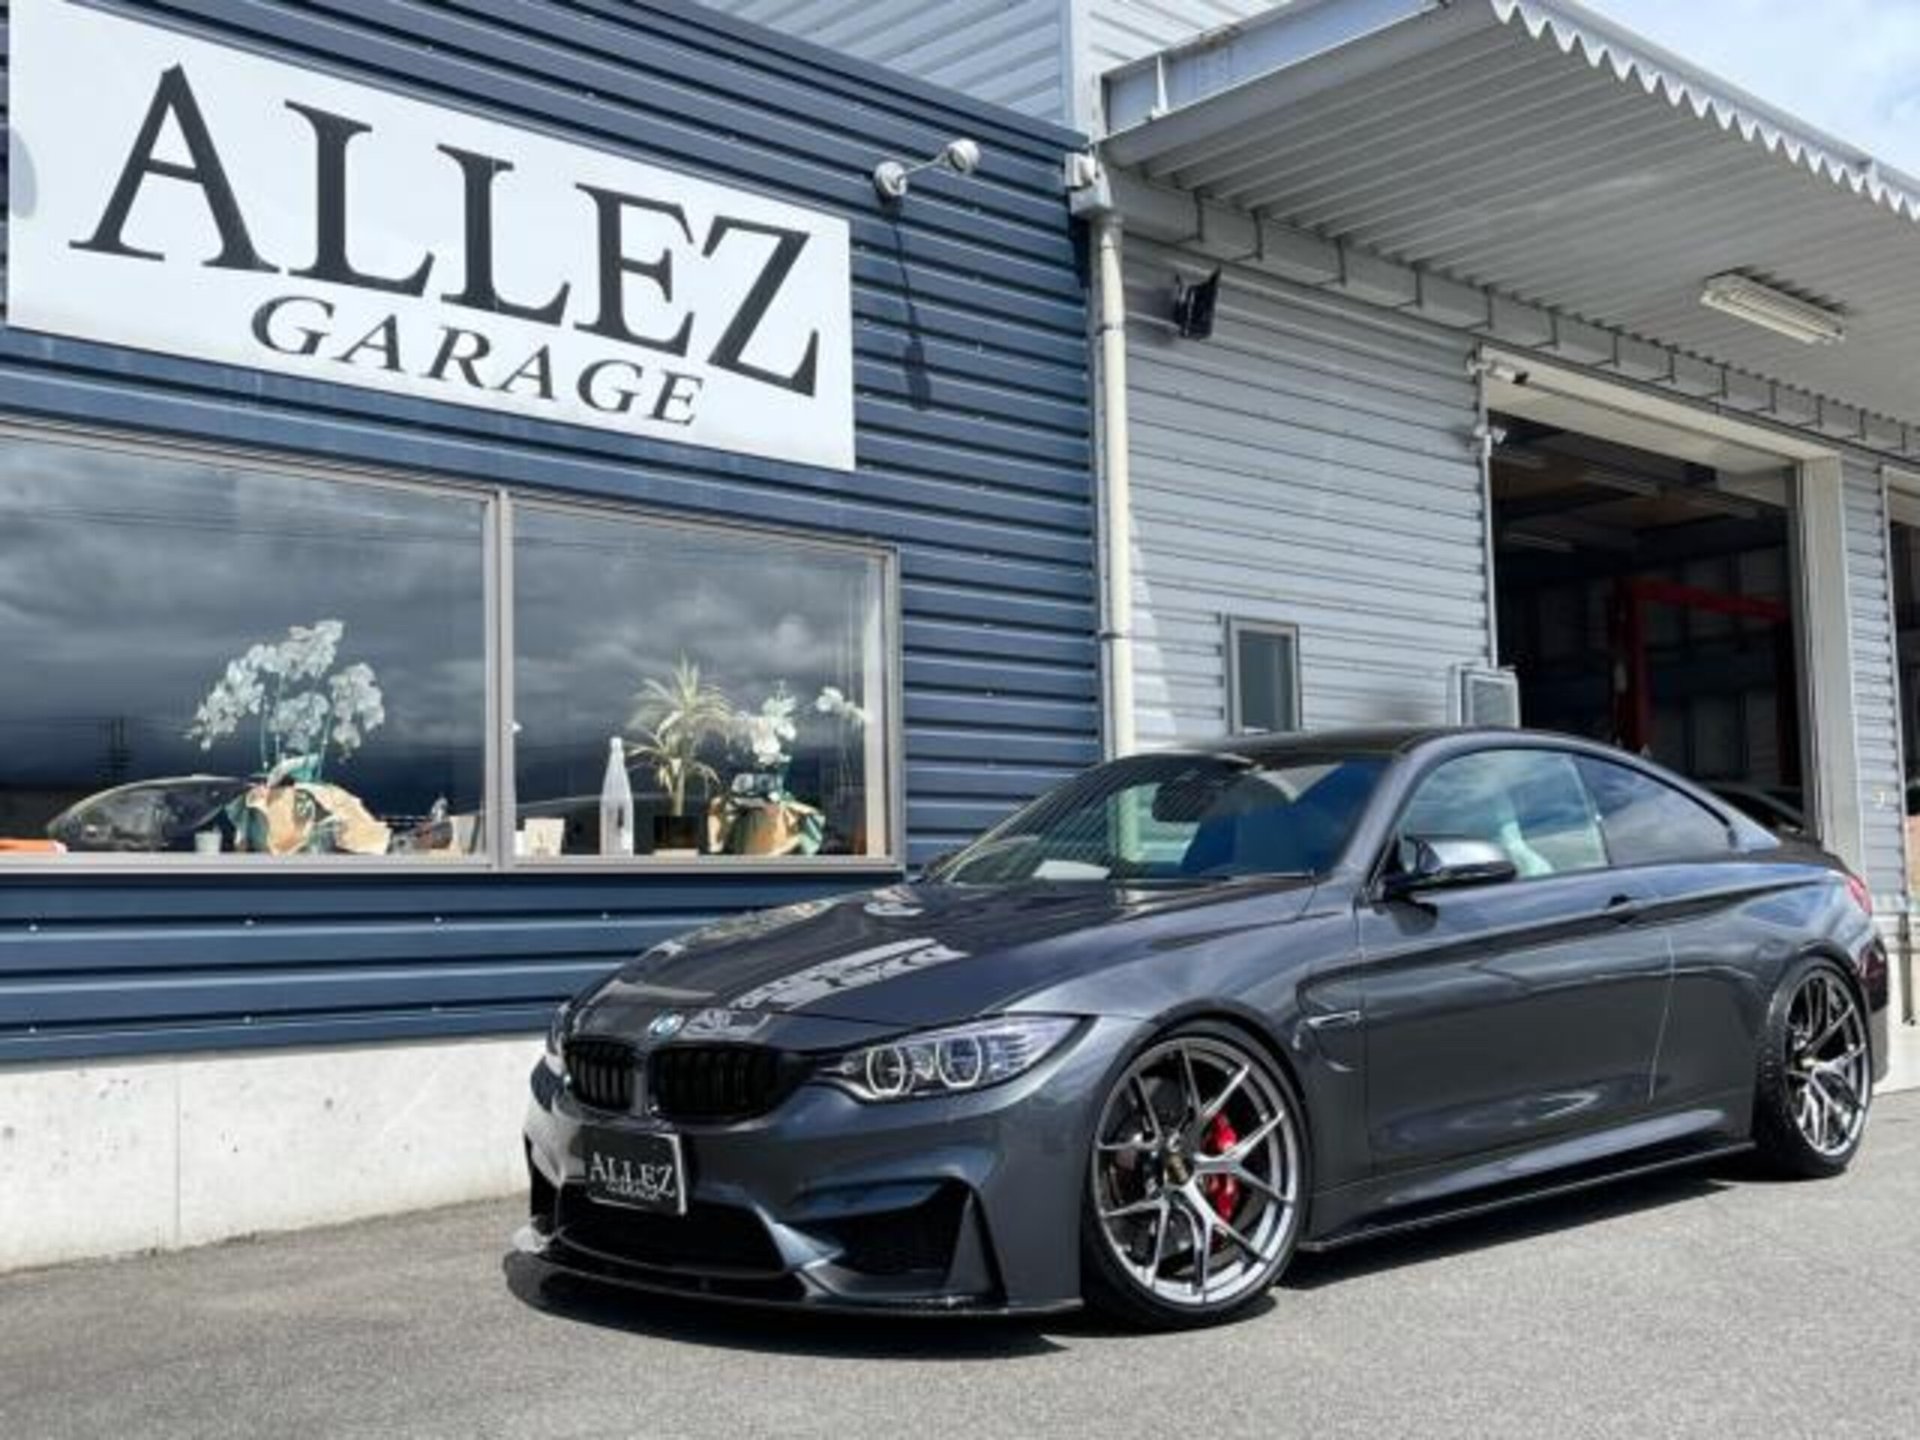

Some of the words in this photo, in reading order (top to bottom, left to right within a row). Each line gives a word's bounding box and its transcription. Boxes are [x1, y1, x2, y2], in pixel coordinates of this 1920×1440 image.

[69, 63, 820, 398] ALLEZ
[251, 295, 704, 427] GARAGE
[589, 1151, 675, 1198] ALLEZ
